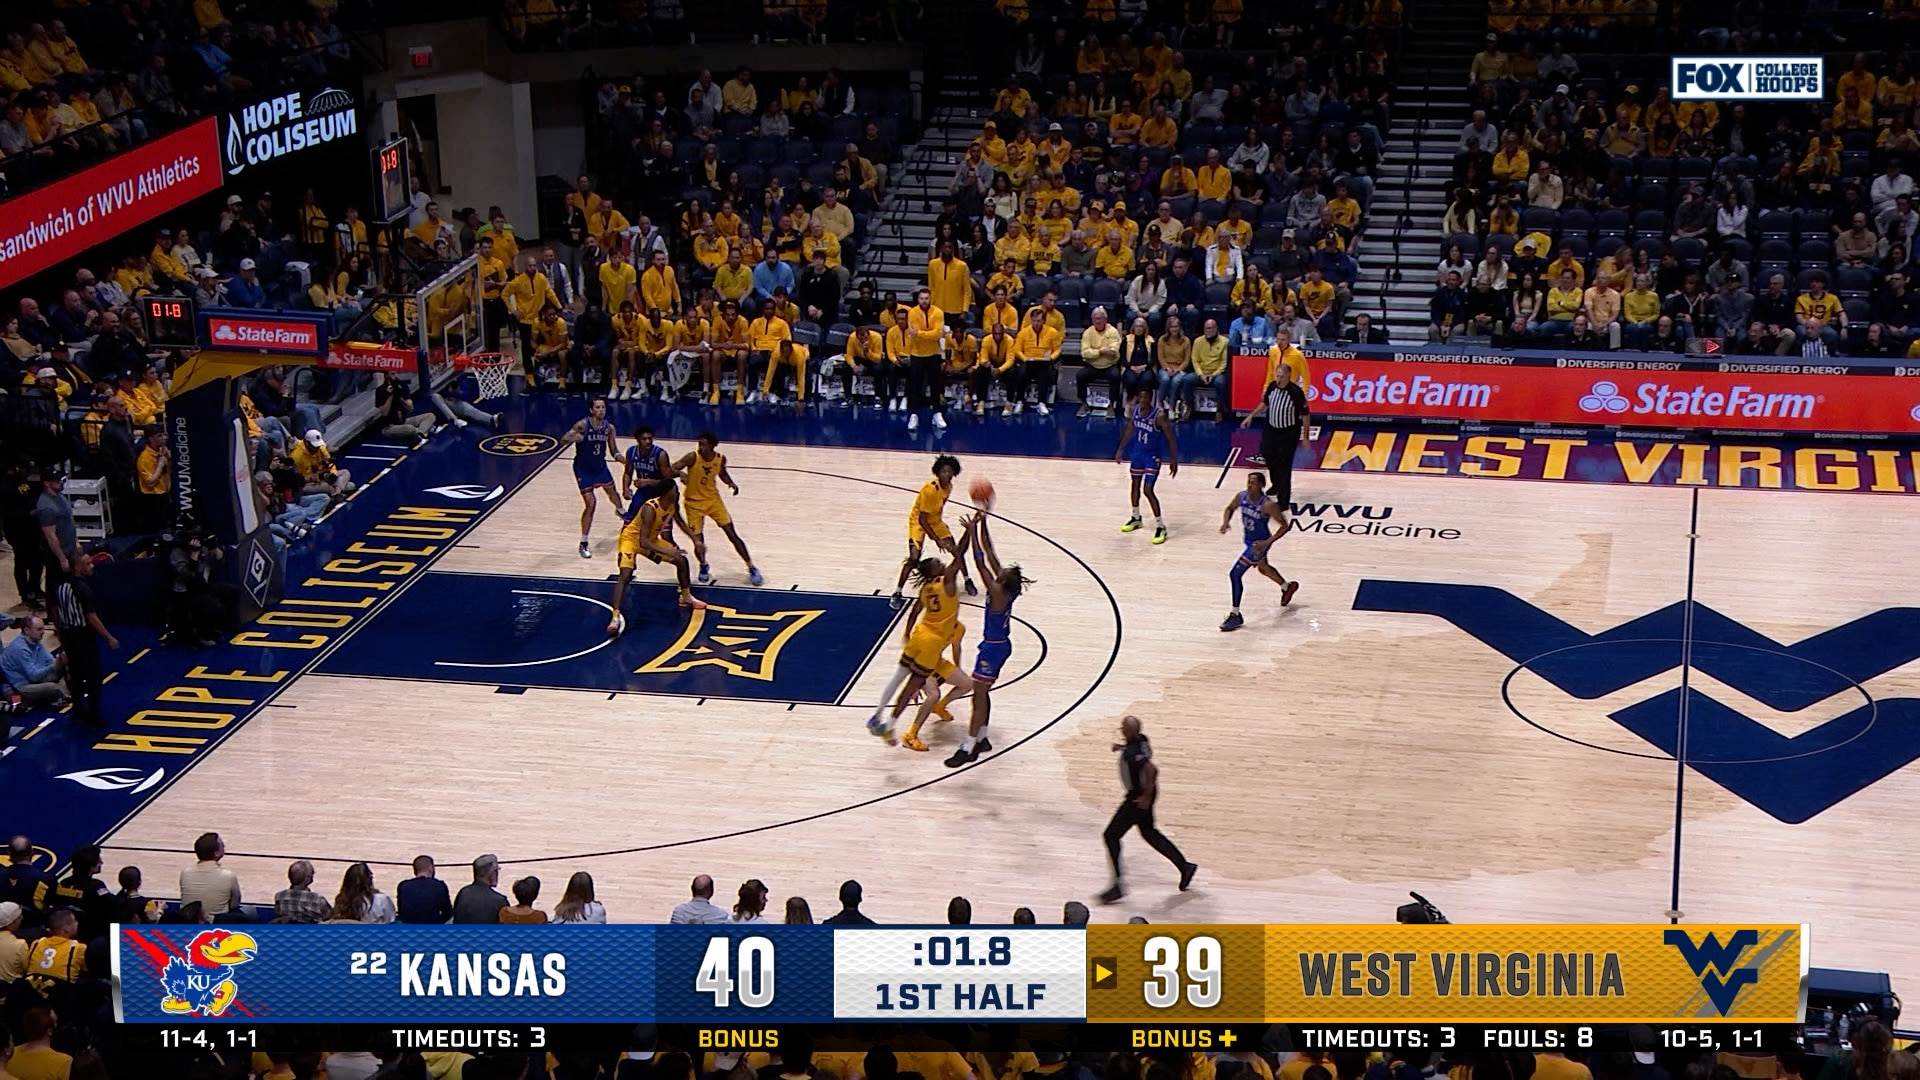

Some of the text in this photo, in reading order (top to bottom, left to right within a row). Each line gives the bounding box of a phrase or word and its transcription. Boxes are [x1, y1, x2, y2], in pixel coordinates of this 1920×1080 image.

[243, 92, 302, 134] HOPE
[246, 109, 357, 165] COLISEUM
[0, 155, 200, 261] sandwich of WVU Athletics
[152, 303, 181, 318] 01.8
[1315, 350, 1357, 360] ENERGY
[1405, 353, 1515, 365] DIVERSIFIED ENERGY
[1568, 360, 1681, 371] DIVERSIFIED ENERGY
[1730, 364, 1848, 375] DIVERSIFIED ENERGY
[1138, 430, 1149, 444] 14
[593, 443, 601, 456] 3
[1320, 430, 1588, 480] WEST
[1288, 502, 1393, 520] WVU
[1287, 518, 1462, 540] Medicine
[230, 505, 480, 649] COLISEUM
[92, 665, 291, 755] HOPE
[39, 947, 57, 969] 3
